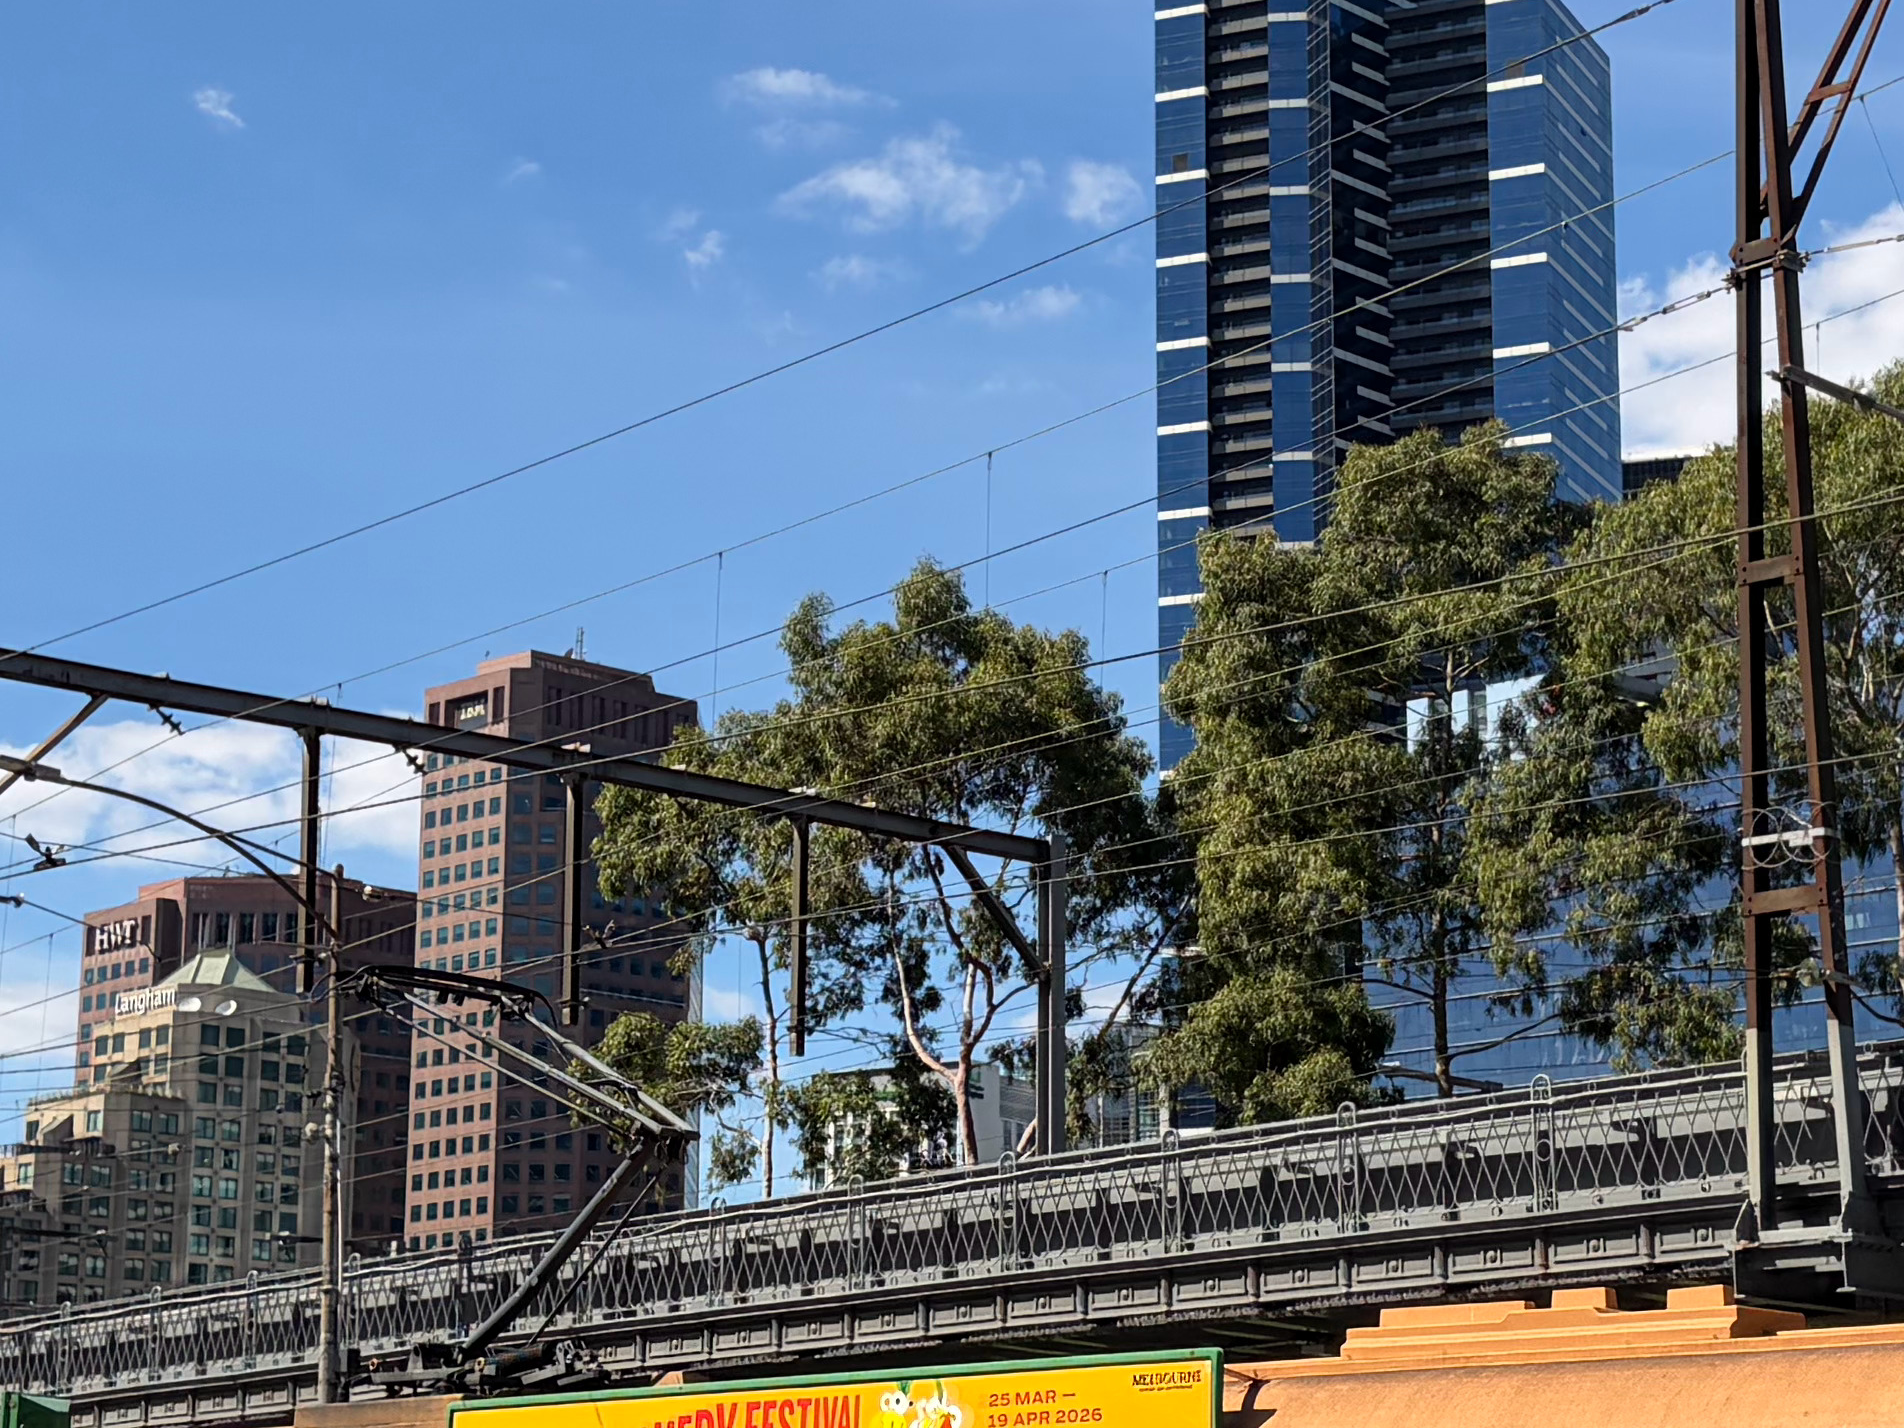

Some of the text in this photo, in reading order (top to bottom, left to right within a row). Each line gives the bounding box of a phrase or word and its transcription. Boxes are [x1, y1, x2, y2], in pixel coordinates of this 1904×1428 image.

[95, 919, 136, 950] HWT
[114, 988, 176, 1016] Langham
[988, 1393, 1011, 1408] 25
[1015, 1390, 1057, 1406] MAR
[987, 1408, 1103, 1428] 19 APR 2026
